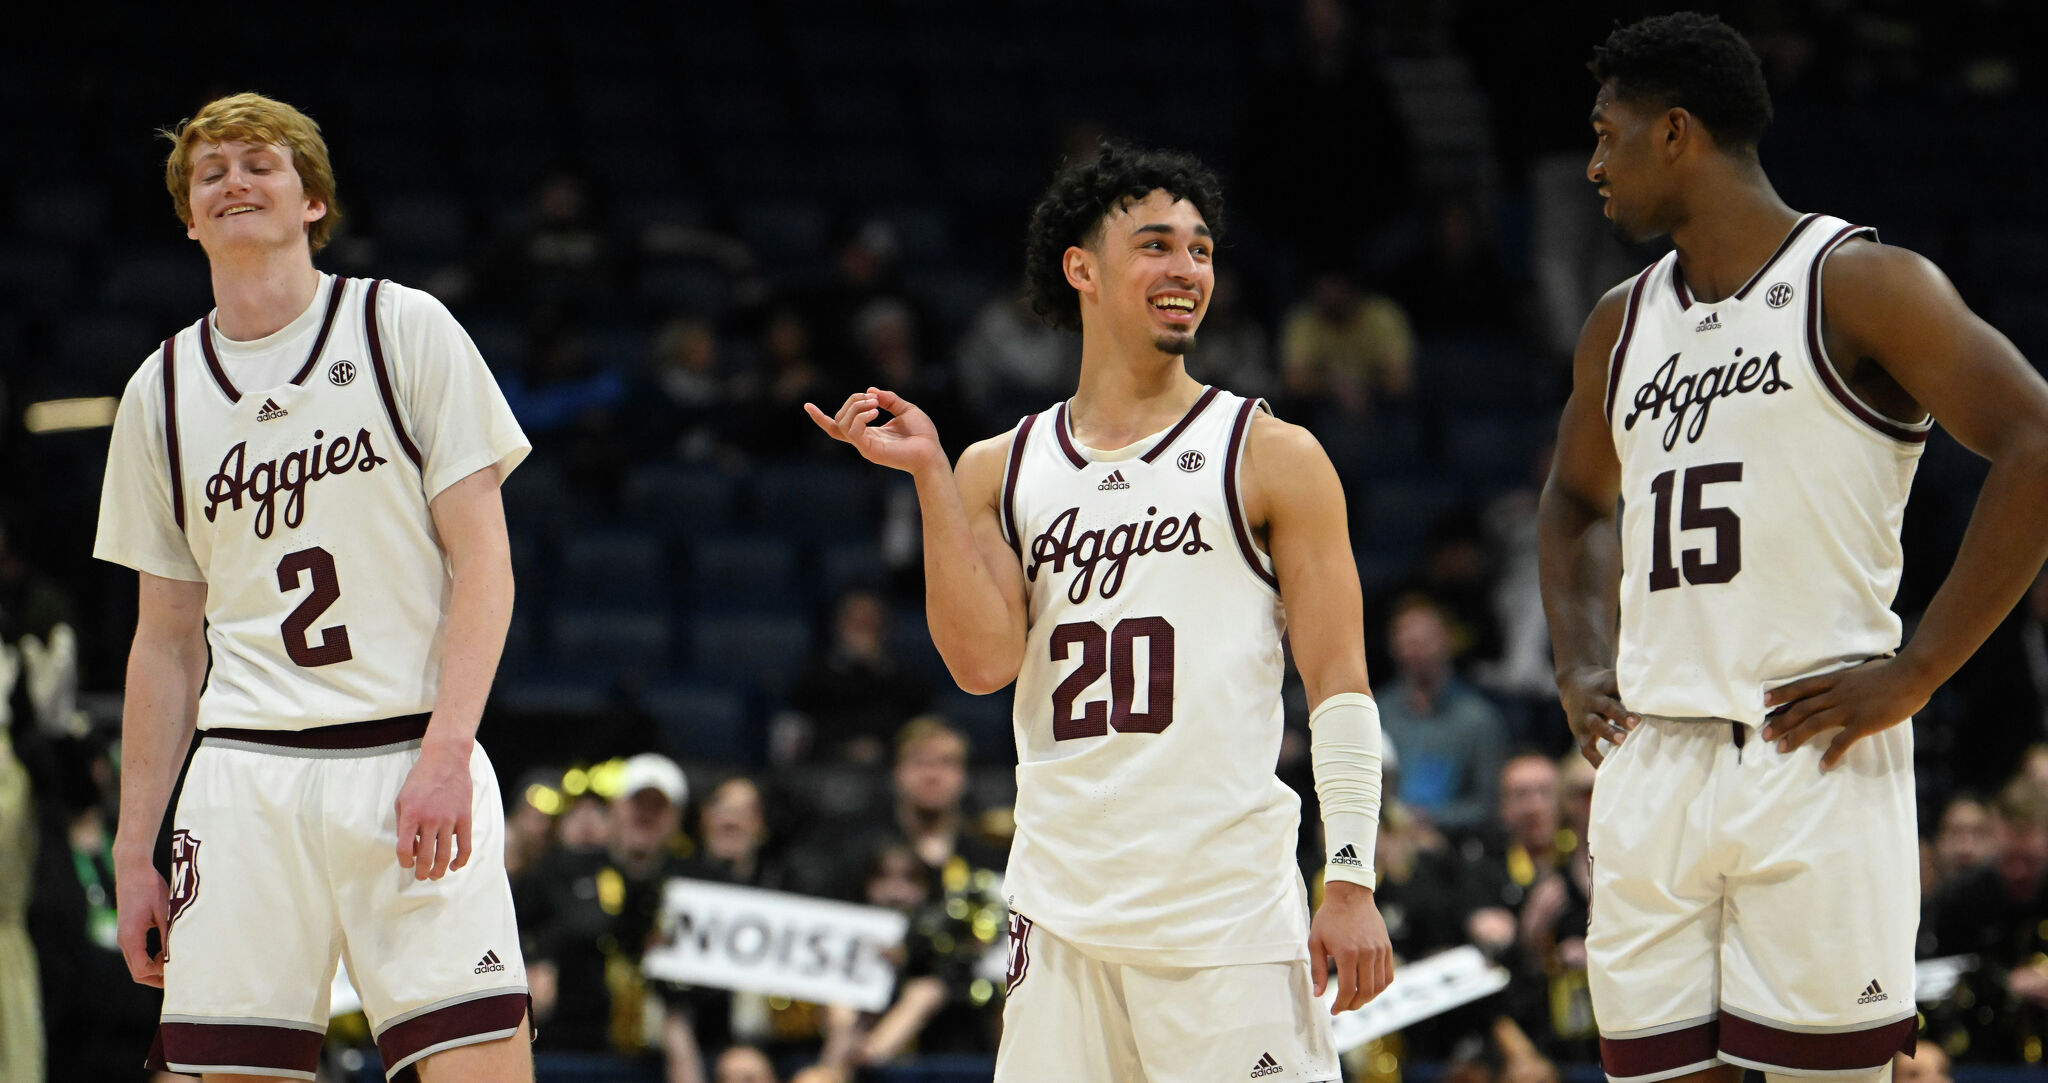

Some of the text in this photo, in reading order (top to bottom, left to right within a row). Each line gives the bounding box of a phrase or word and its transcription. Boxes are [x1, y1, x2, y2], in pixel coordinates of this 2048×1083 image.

[1769, 286, 1791, 305] SEC
[1695, 322, 1722, 333] adidas
[331, 361, 355, 384] SEC
[1624, 347, 1793, 452] Aggies
[256, 407, 288, 422] adidas
[1180, 453, 1203, 470] SEC
[204, 428, 388, 539] Aggies
[1097, 481, 1130, 491] adidas
[1649, 462, 1743, 592] 15
[1027, 506, 1213, 604] Aggies
[276, 546, 353, 667] 2
[1050, 616, 1175, 741] 20
[1331, 855, 1362, 868] adidas
[668, 912, 882, 985] NOISE
[474, 961, 505, 975] adidas
[1857, 991, 1888, 1004] adidas
[1250, 1064, 1283, 1079] adidas
